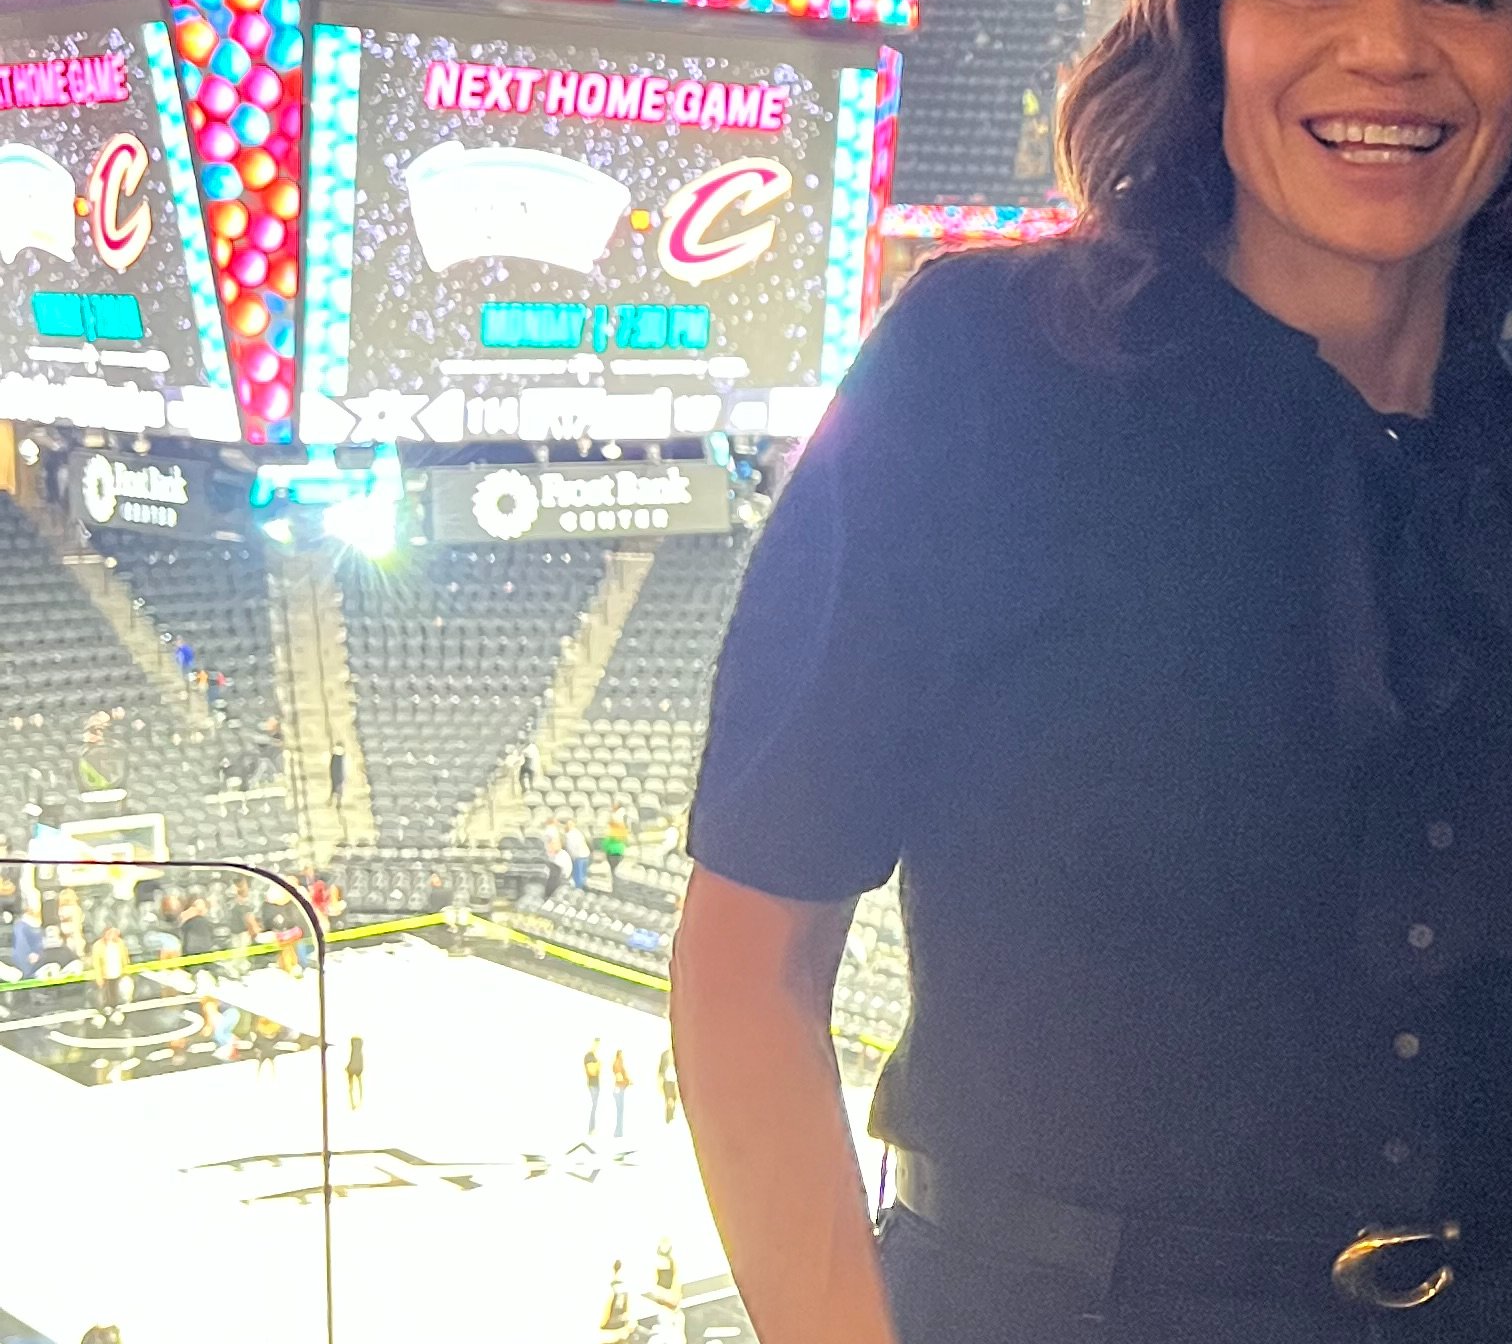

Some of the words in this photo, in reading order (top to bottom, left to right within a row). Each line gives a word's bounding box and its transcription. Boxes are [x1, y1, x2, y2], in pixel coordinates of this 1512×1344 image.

[427, 62, 543, 113] NEXT
[545, 70, 669, 121] HOME
[670, 80, 789, 131] GAME
